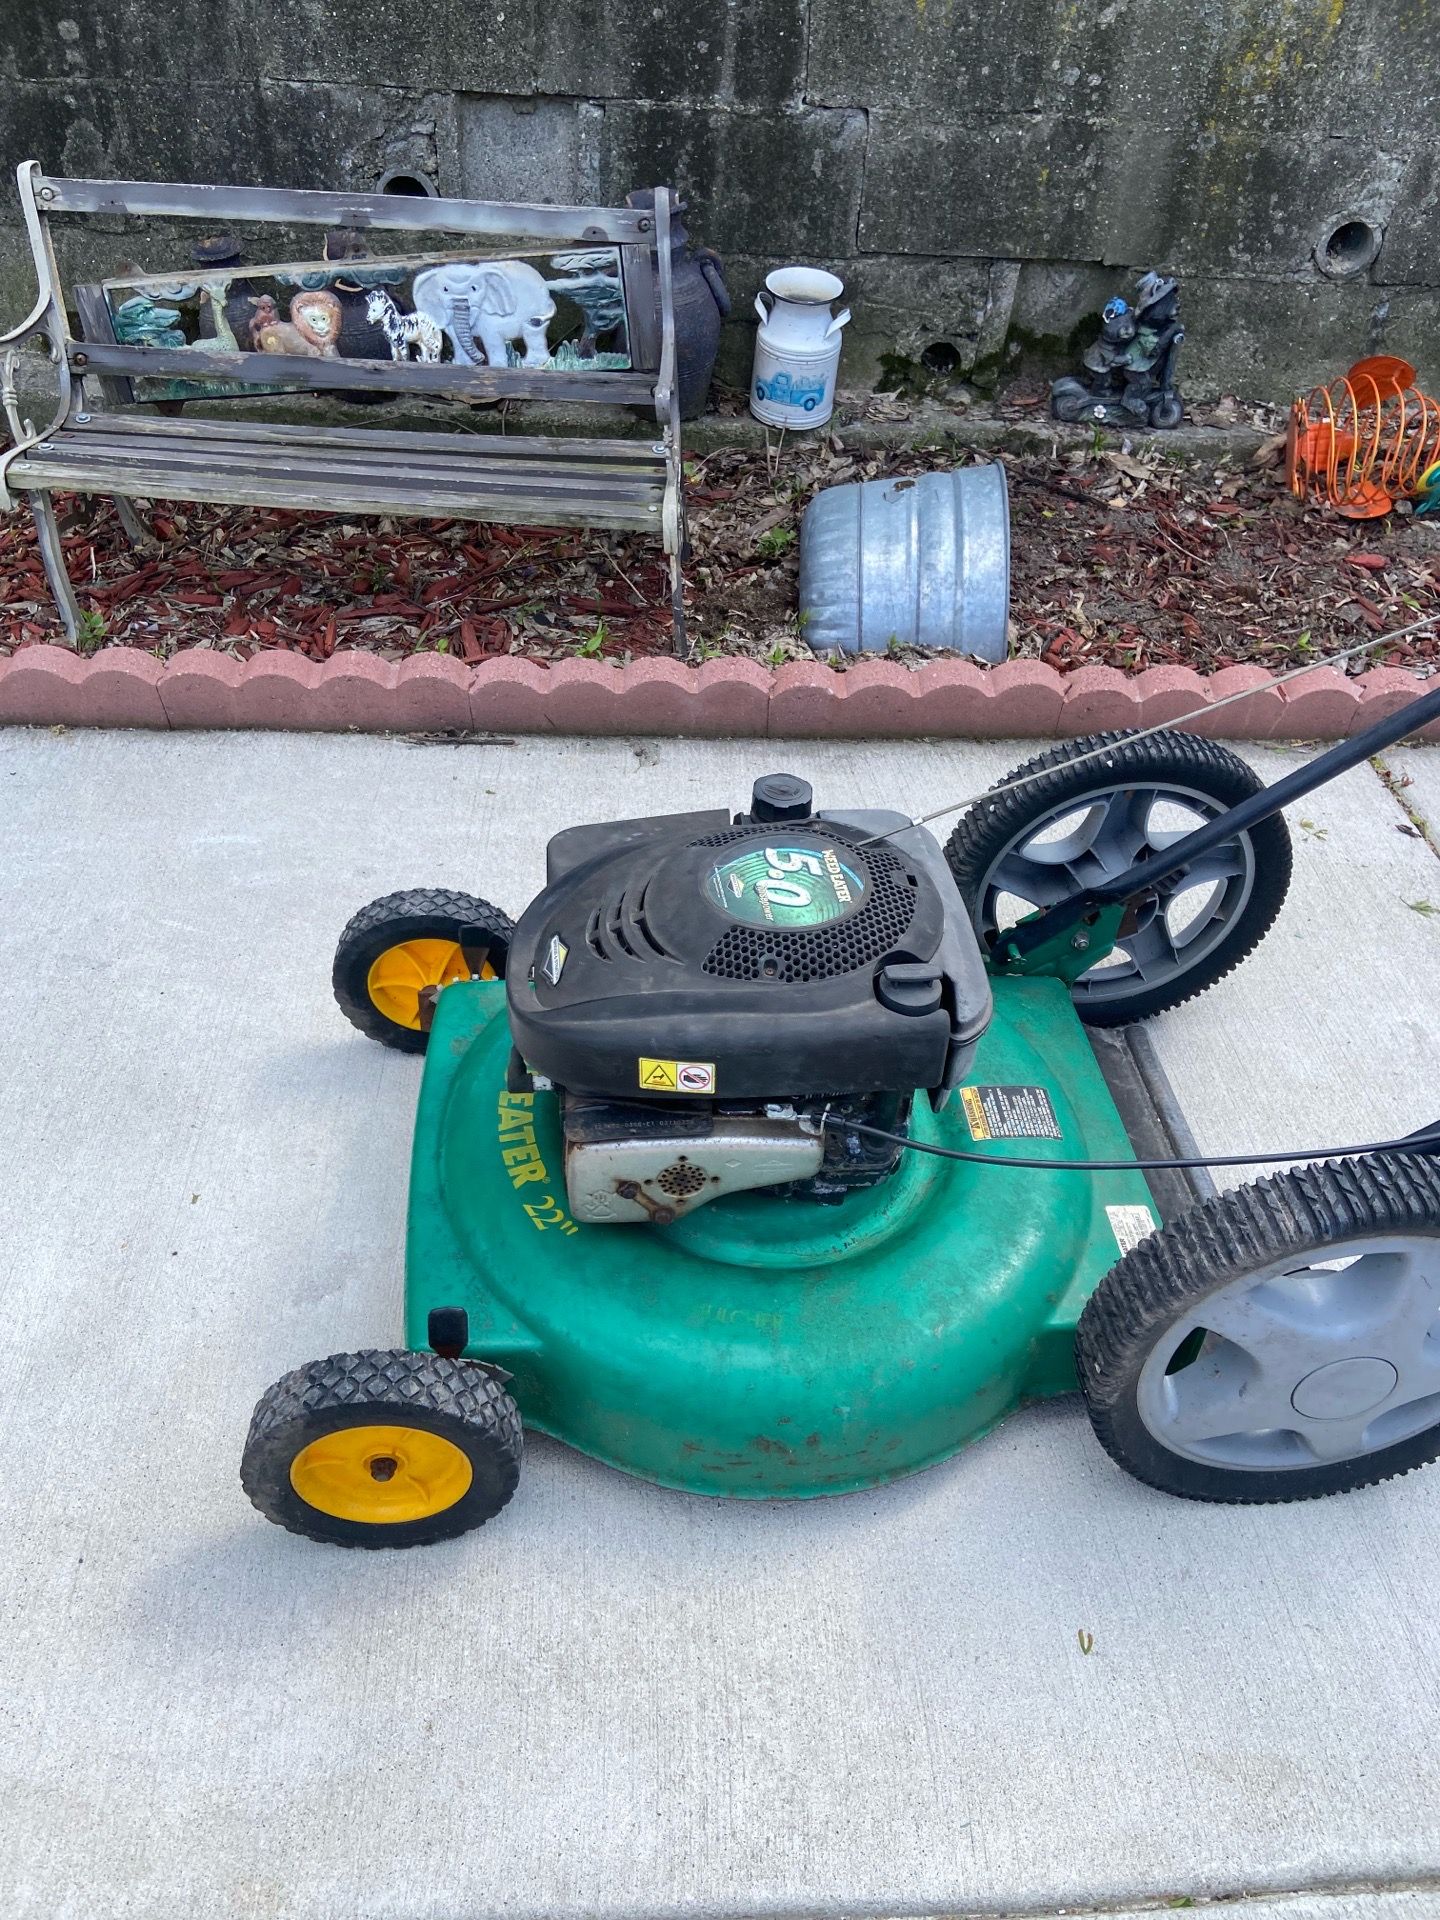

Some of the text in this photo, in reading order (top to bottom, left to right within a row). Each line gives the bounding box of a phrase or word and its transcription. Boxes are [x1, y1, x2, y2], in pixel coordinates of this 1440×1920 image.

[755, 848, 823, 907] 5.0
[822, 849, 852, 903] WEED EATER
[498, 1090, 547, 1190] EATER
[523, 1195, 579, 1236] 22"
